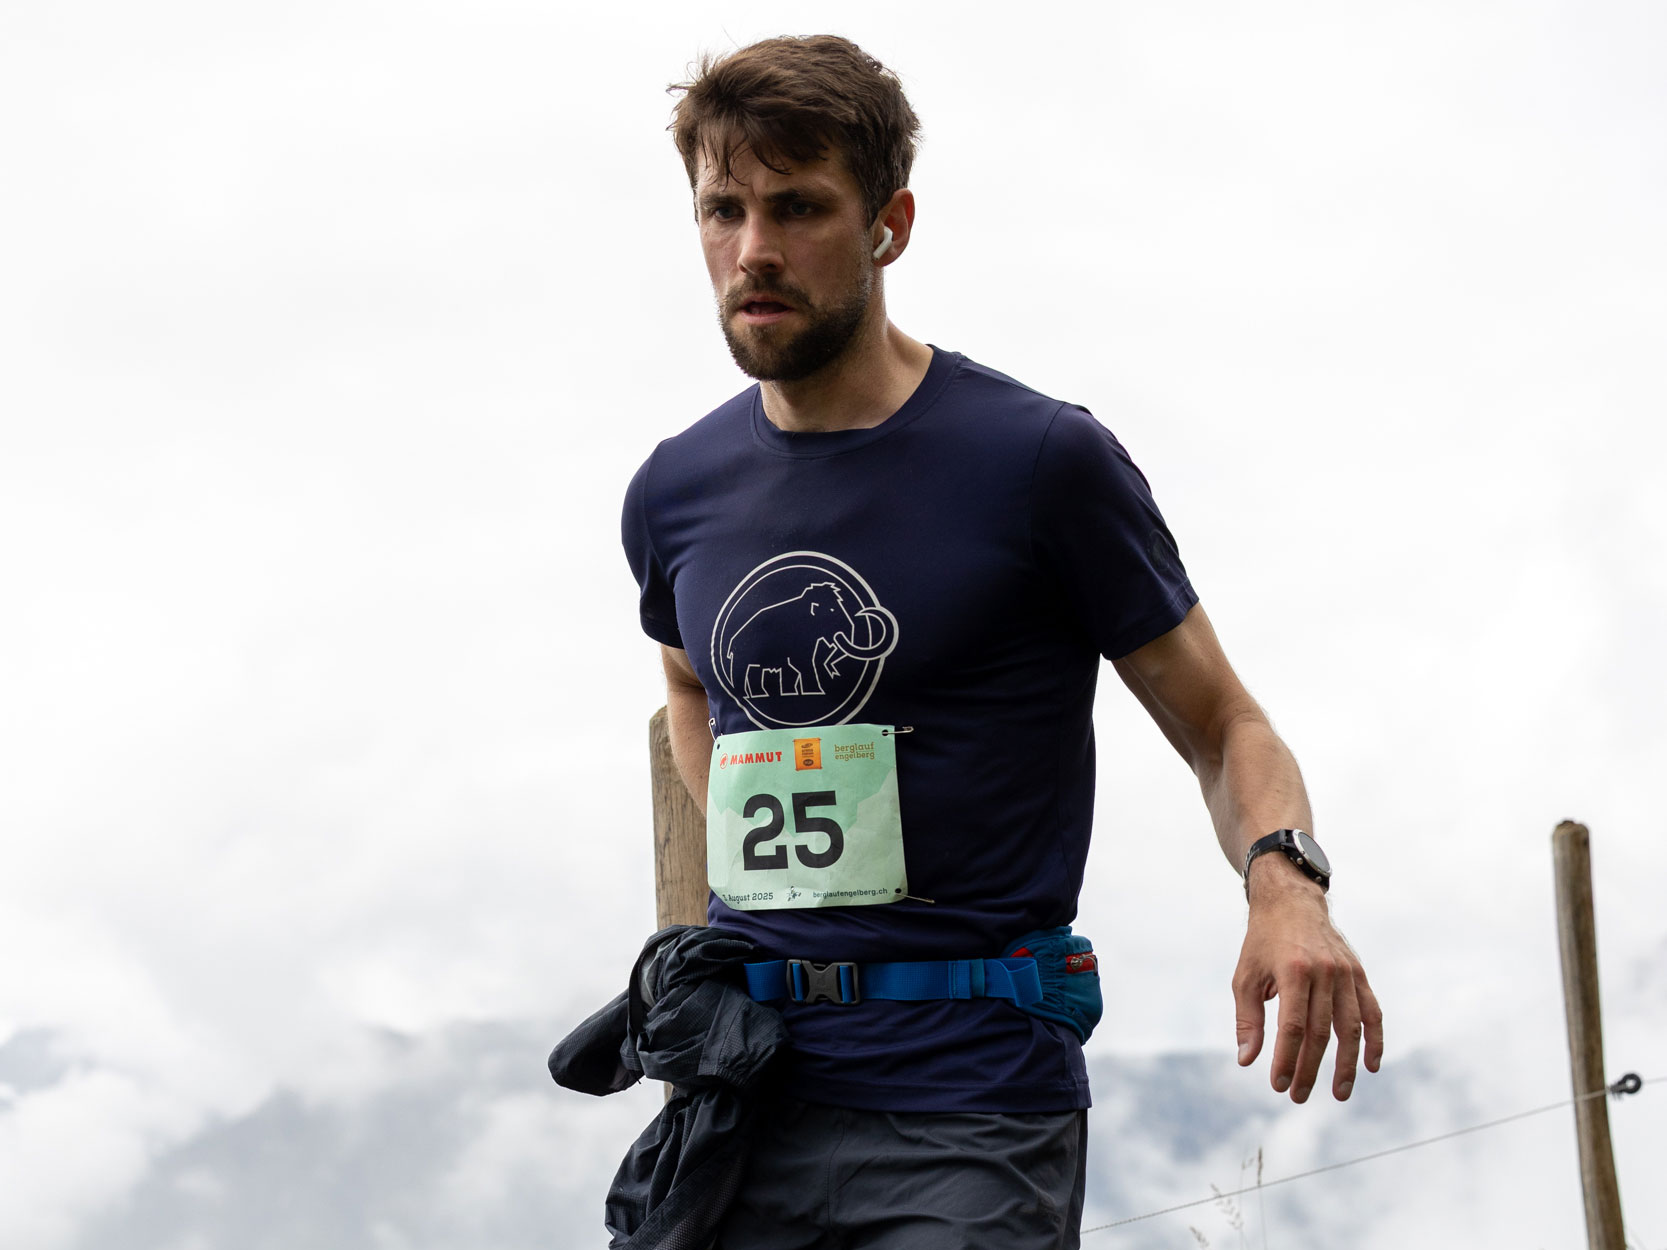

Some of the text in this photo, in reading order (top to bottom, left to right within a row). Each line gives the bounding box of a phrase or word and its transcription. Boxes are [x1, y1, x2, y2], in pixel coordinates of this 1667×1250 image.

[834, 741, 874, 753] berglauf
[730, 751, 782, 765] MAMMUT
[834, 751, 875, 762] engelberg
[742, 790, 845, 871] 25
[728, 894, 750, 904] August
[751, 892, 774, 901] 2025
[812, 887, 888, 899] berglaufengelberg.ch
